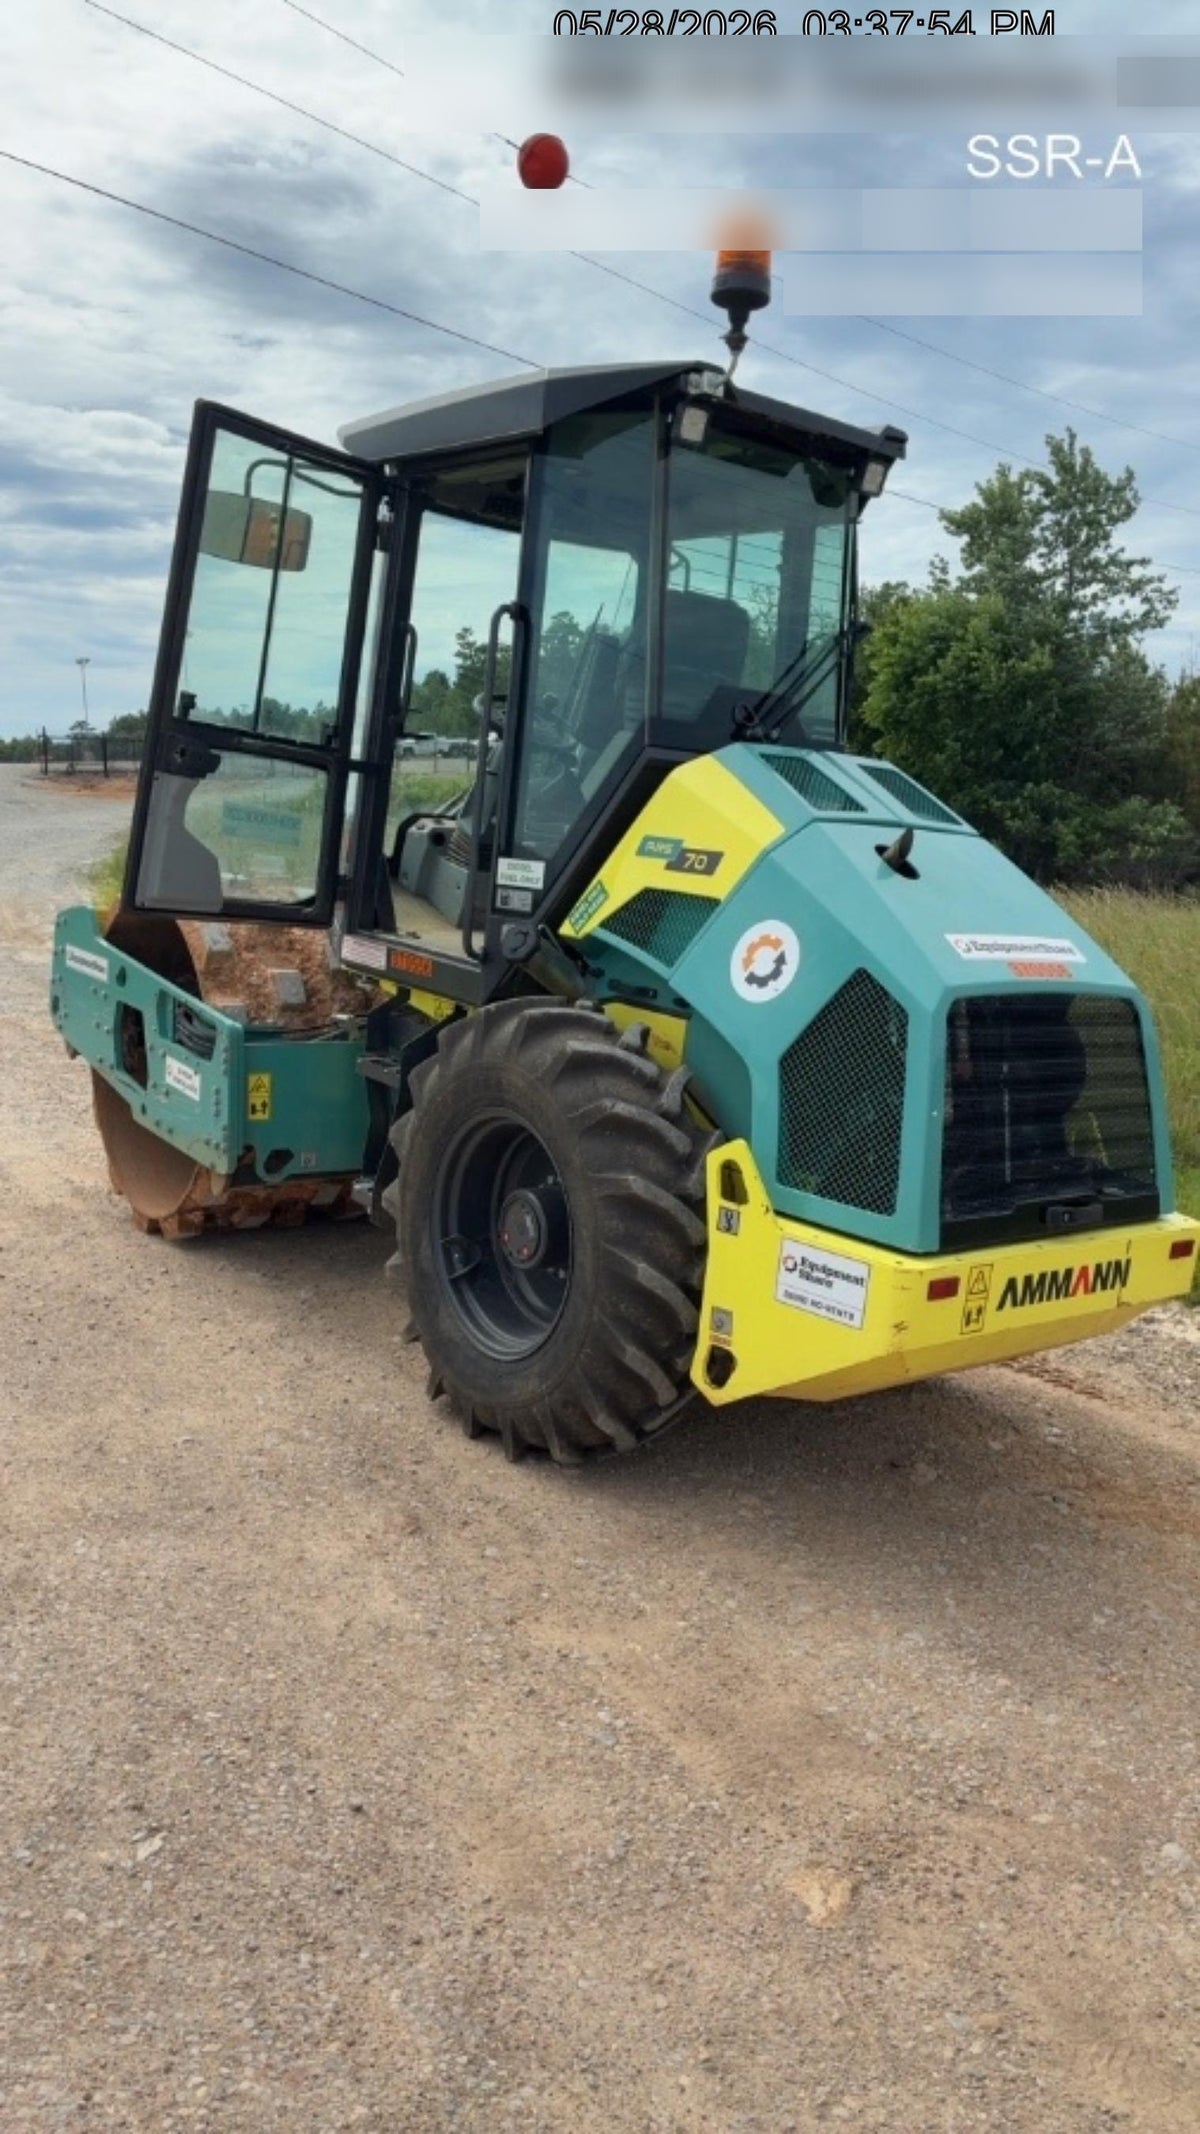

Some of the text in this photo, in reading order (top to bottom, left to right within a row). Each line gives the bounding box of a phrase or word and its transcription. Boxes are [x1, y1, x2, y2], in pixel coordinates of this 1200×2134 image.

[682, 852, 708, 870] 70
[798, 1268, 834, 1289] Share
[800, 1256, 865, 1288] Equipment
[995, 1258, 1132, 1312] AMMANN
